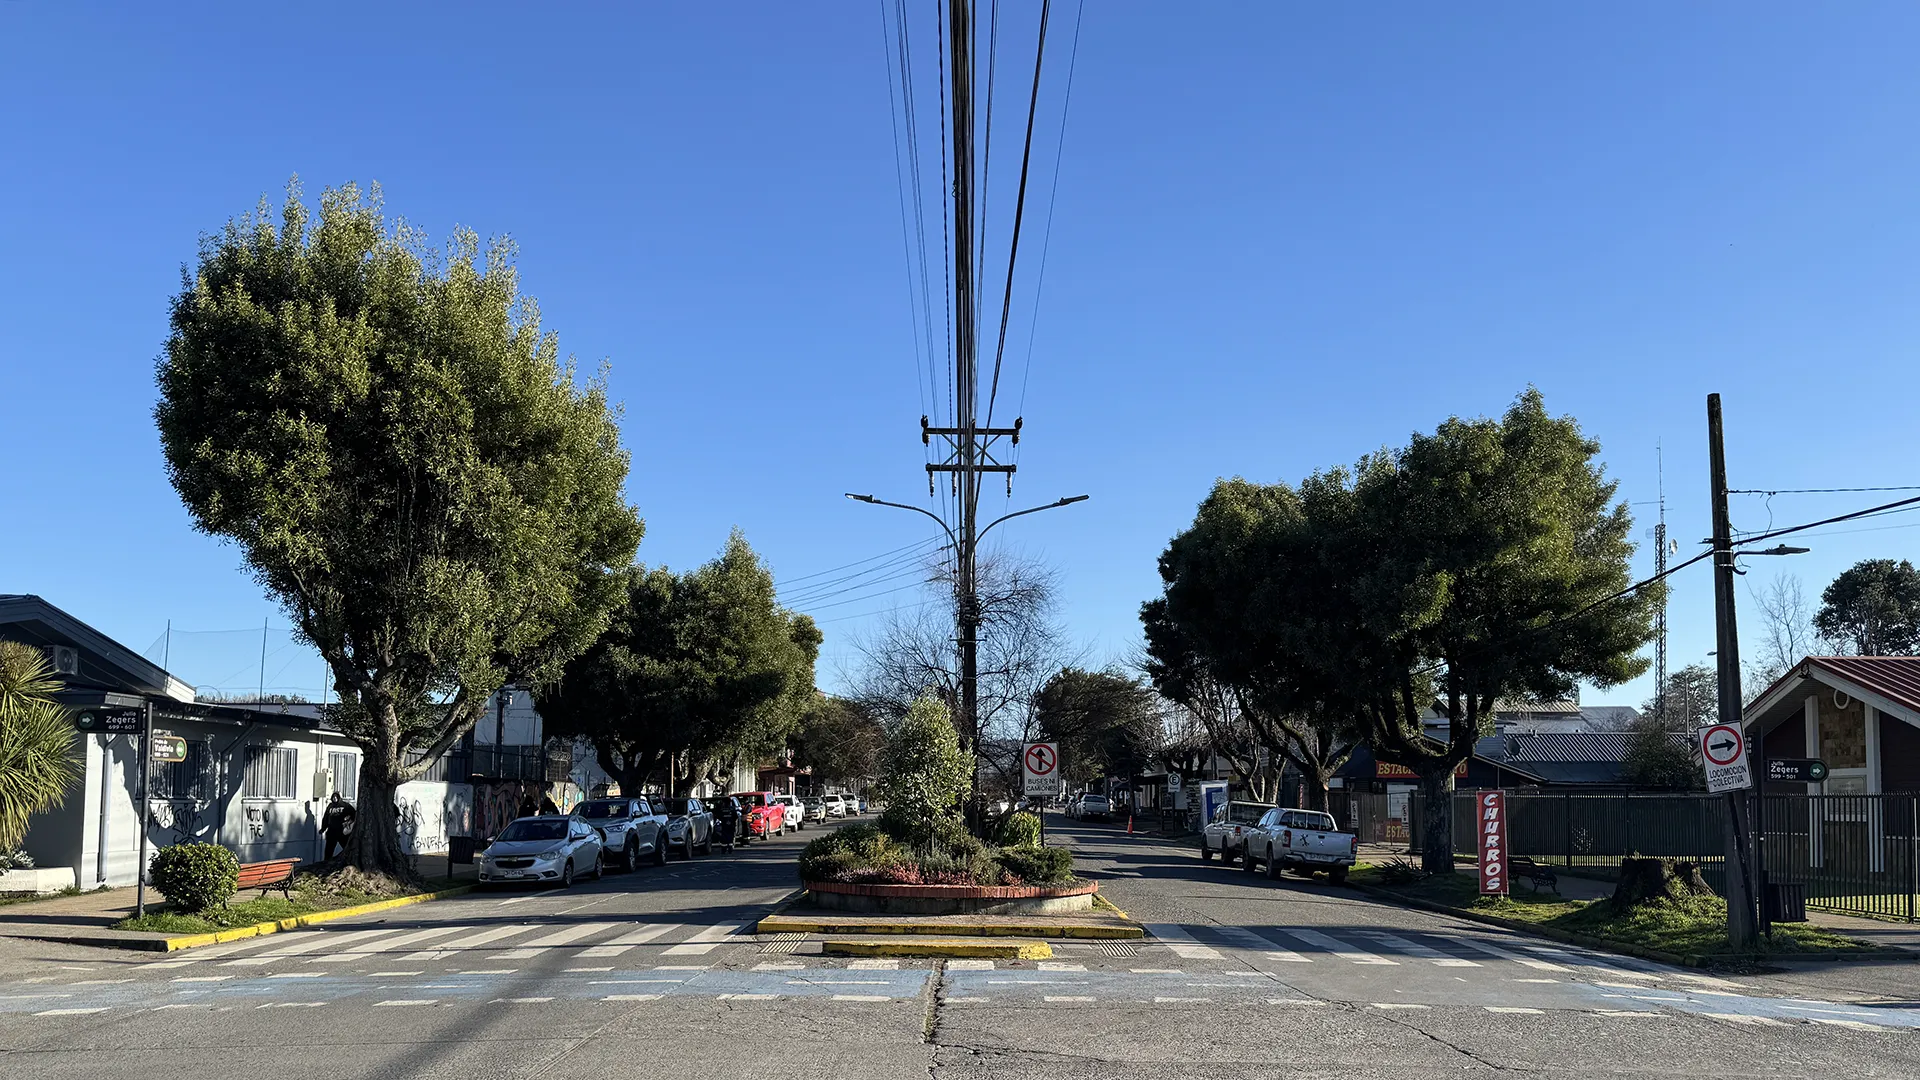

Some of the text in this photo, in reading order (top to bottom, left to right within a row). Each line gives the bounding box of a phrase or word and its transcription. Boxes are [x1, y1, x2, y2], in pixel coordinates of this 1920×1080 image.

[106, 716, 136, 724] Zegers
[1771, 765, 1799, 774] Zegers
[1712, 774, 1745, 787] COLECTIVA
[1483, 793, 1501, 890] CHURROS
